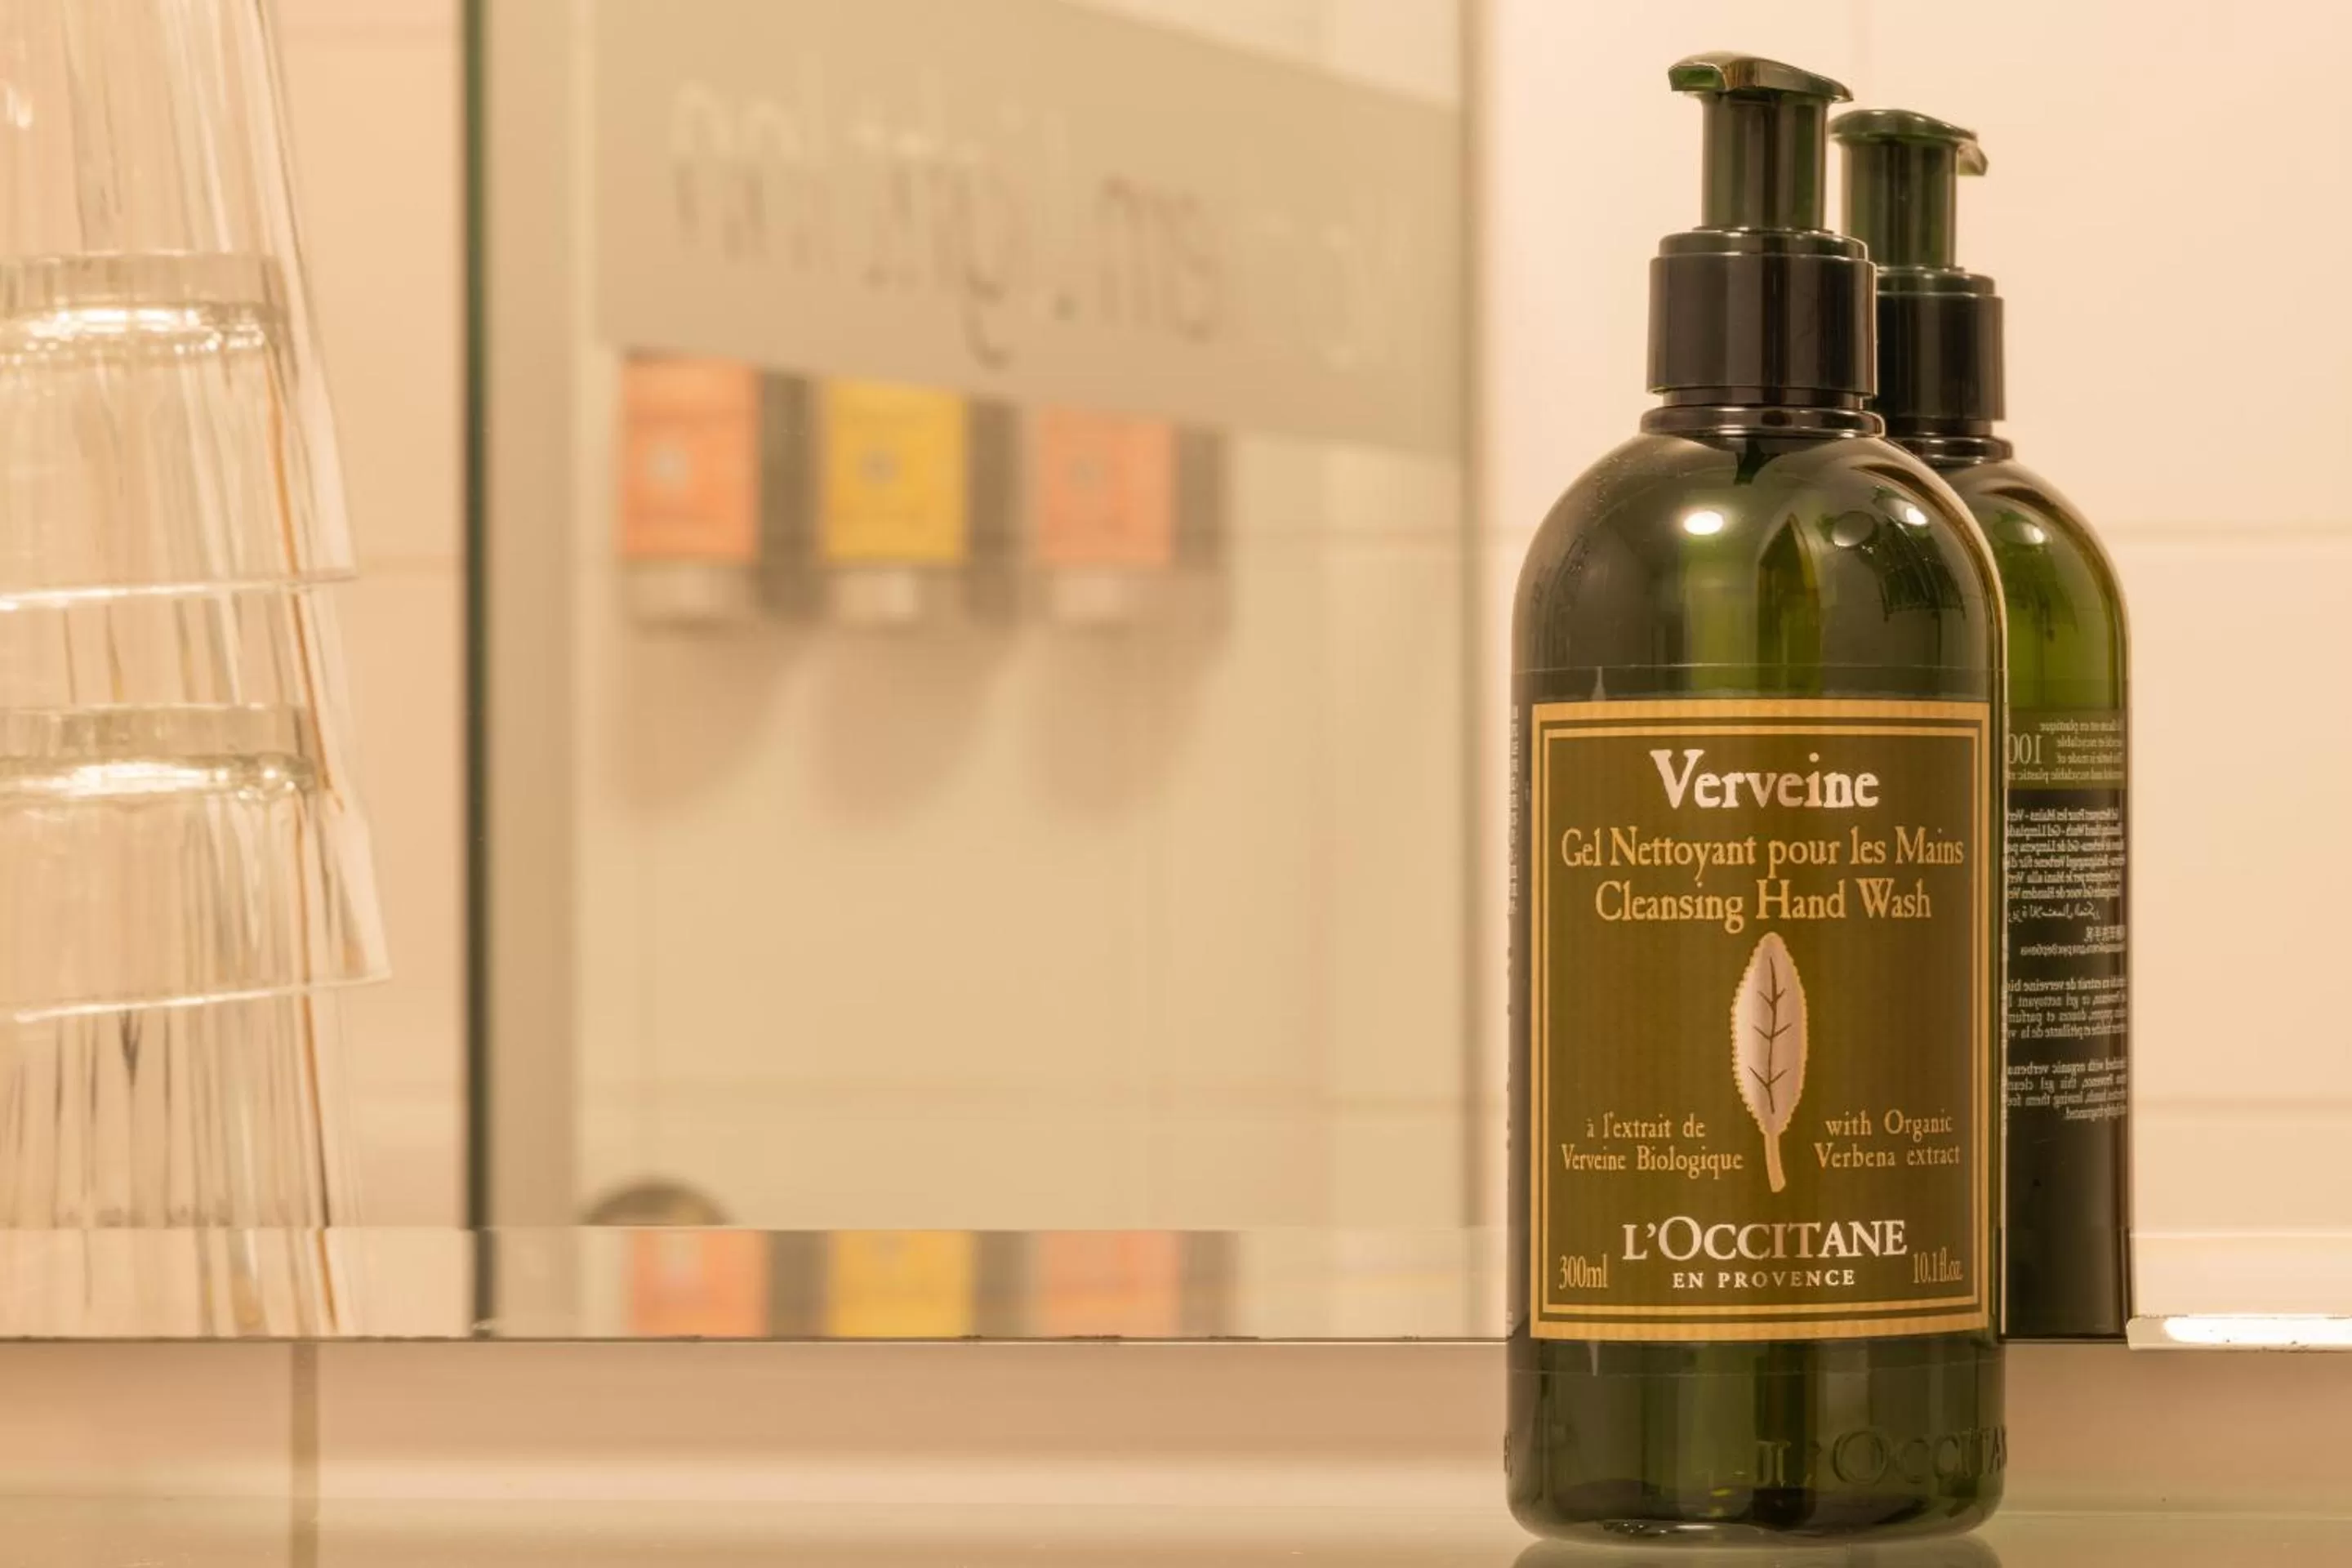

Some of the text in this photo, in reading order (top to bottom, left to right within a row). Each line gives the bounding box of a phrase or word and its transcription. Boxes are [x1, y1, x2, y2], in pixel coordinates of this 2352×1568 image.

[1650, 749, 1879, 809] Verveine
[1561, 826, 1964, 881] Gel Nettoyant pour les Mains
[1595, 877, 1932, 933] Cleansing Hand Wash
[1586, 1112, 1706, 1138] à l'extrait de
[1825, 1109, 1953, 1142] with Organic
[1561, 1144, 1744, 1178] Verveine Biologique
[1815, 1143, 1962, 1169] Verbena extract
[1622, 1215, 1908, 1262] L'OCCITANE
[1559, 1254, 1608, 1290] 300ml
[1673, 1270, 1855, 1289] EN PROVENCE
